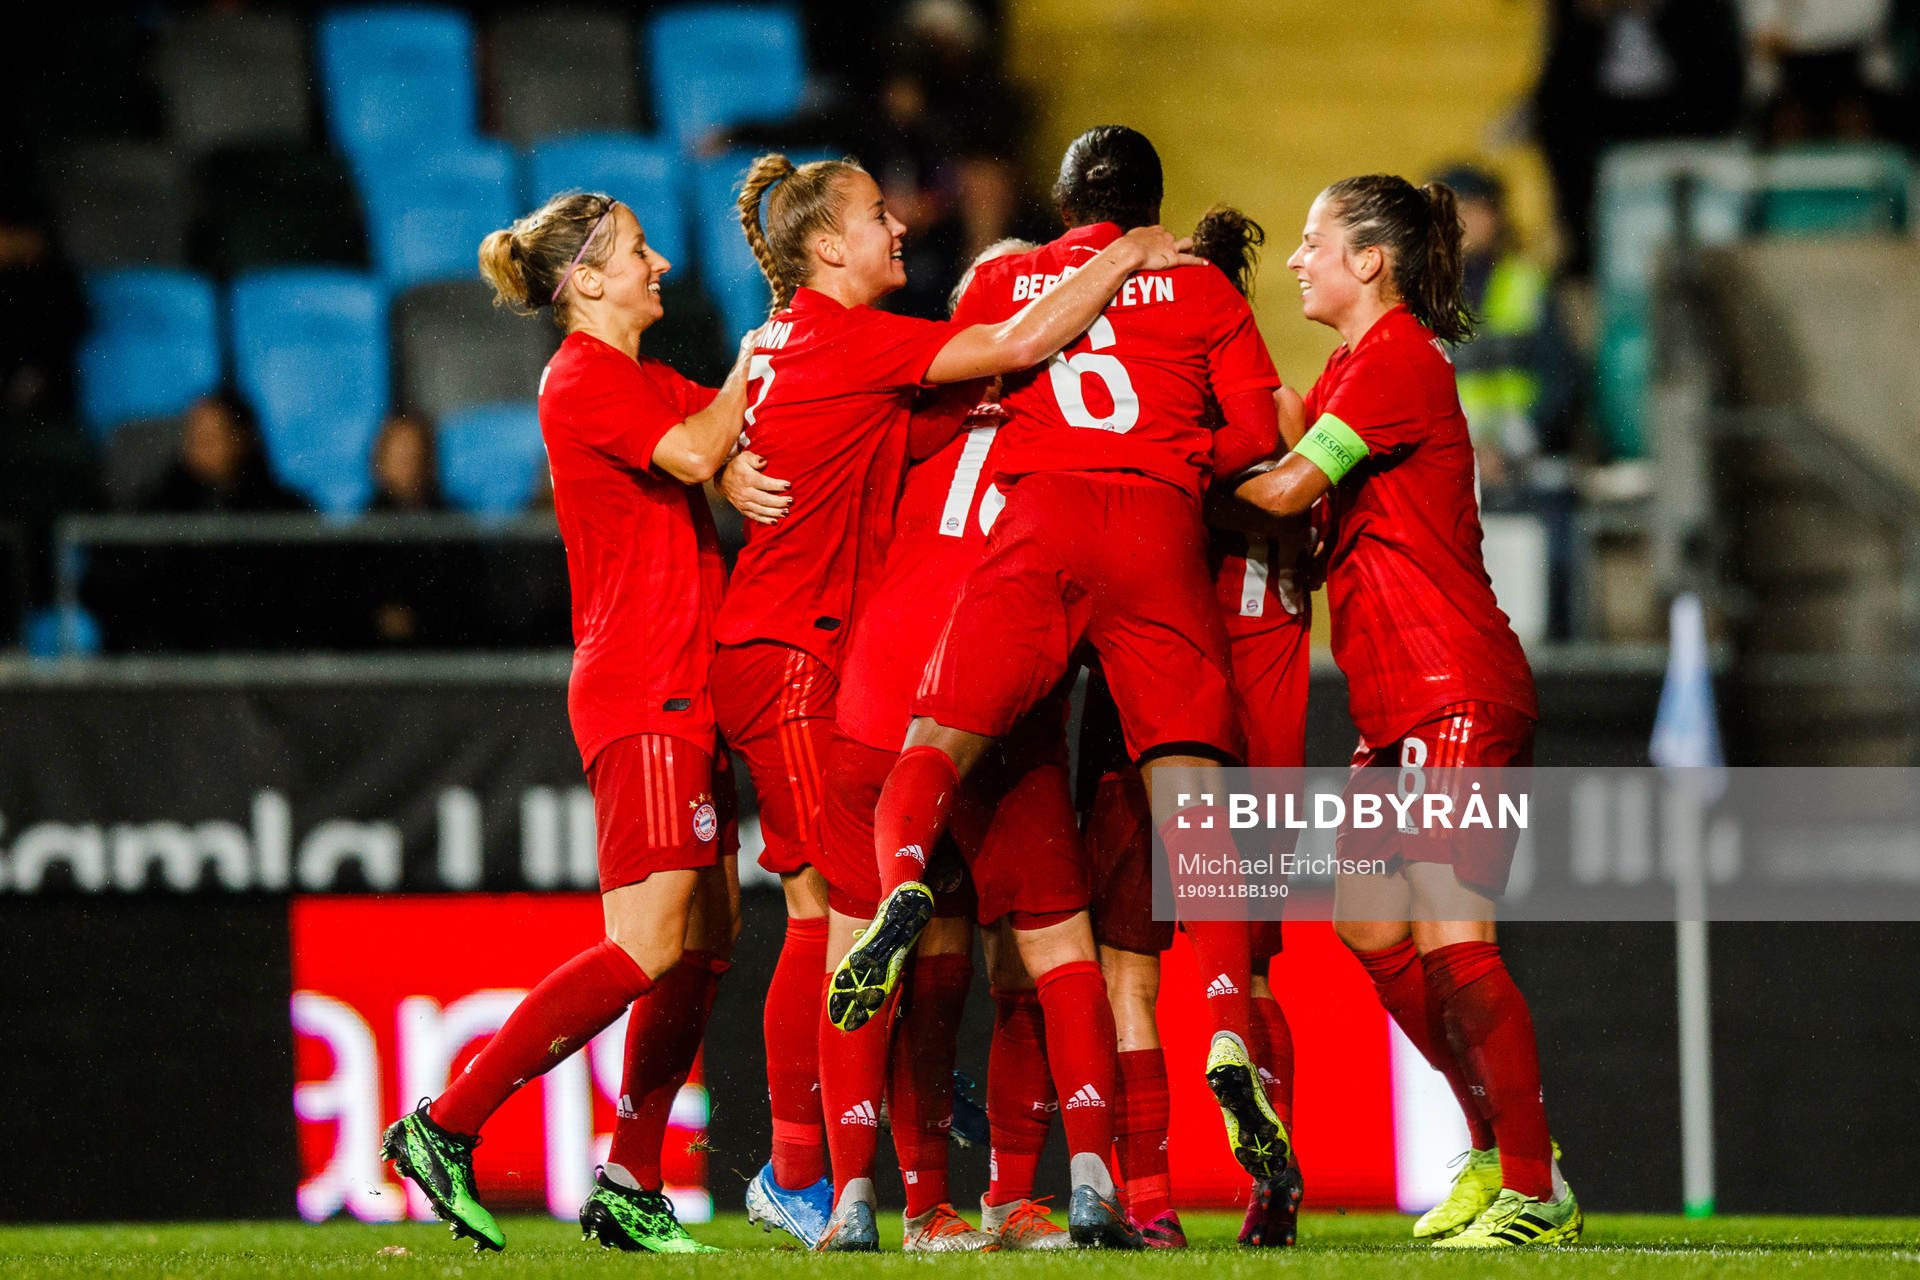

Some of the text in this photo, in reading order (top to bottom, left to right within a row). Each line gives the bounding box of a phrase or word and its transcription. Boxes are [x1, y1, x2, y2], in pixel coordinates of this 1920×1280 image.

[1048, 314, 1140, 434] 6
[1397, 737, 1428, 802] 8
[0, 785, 402, 893] amla
